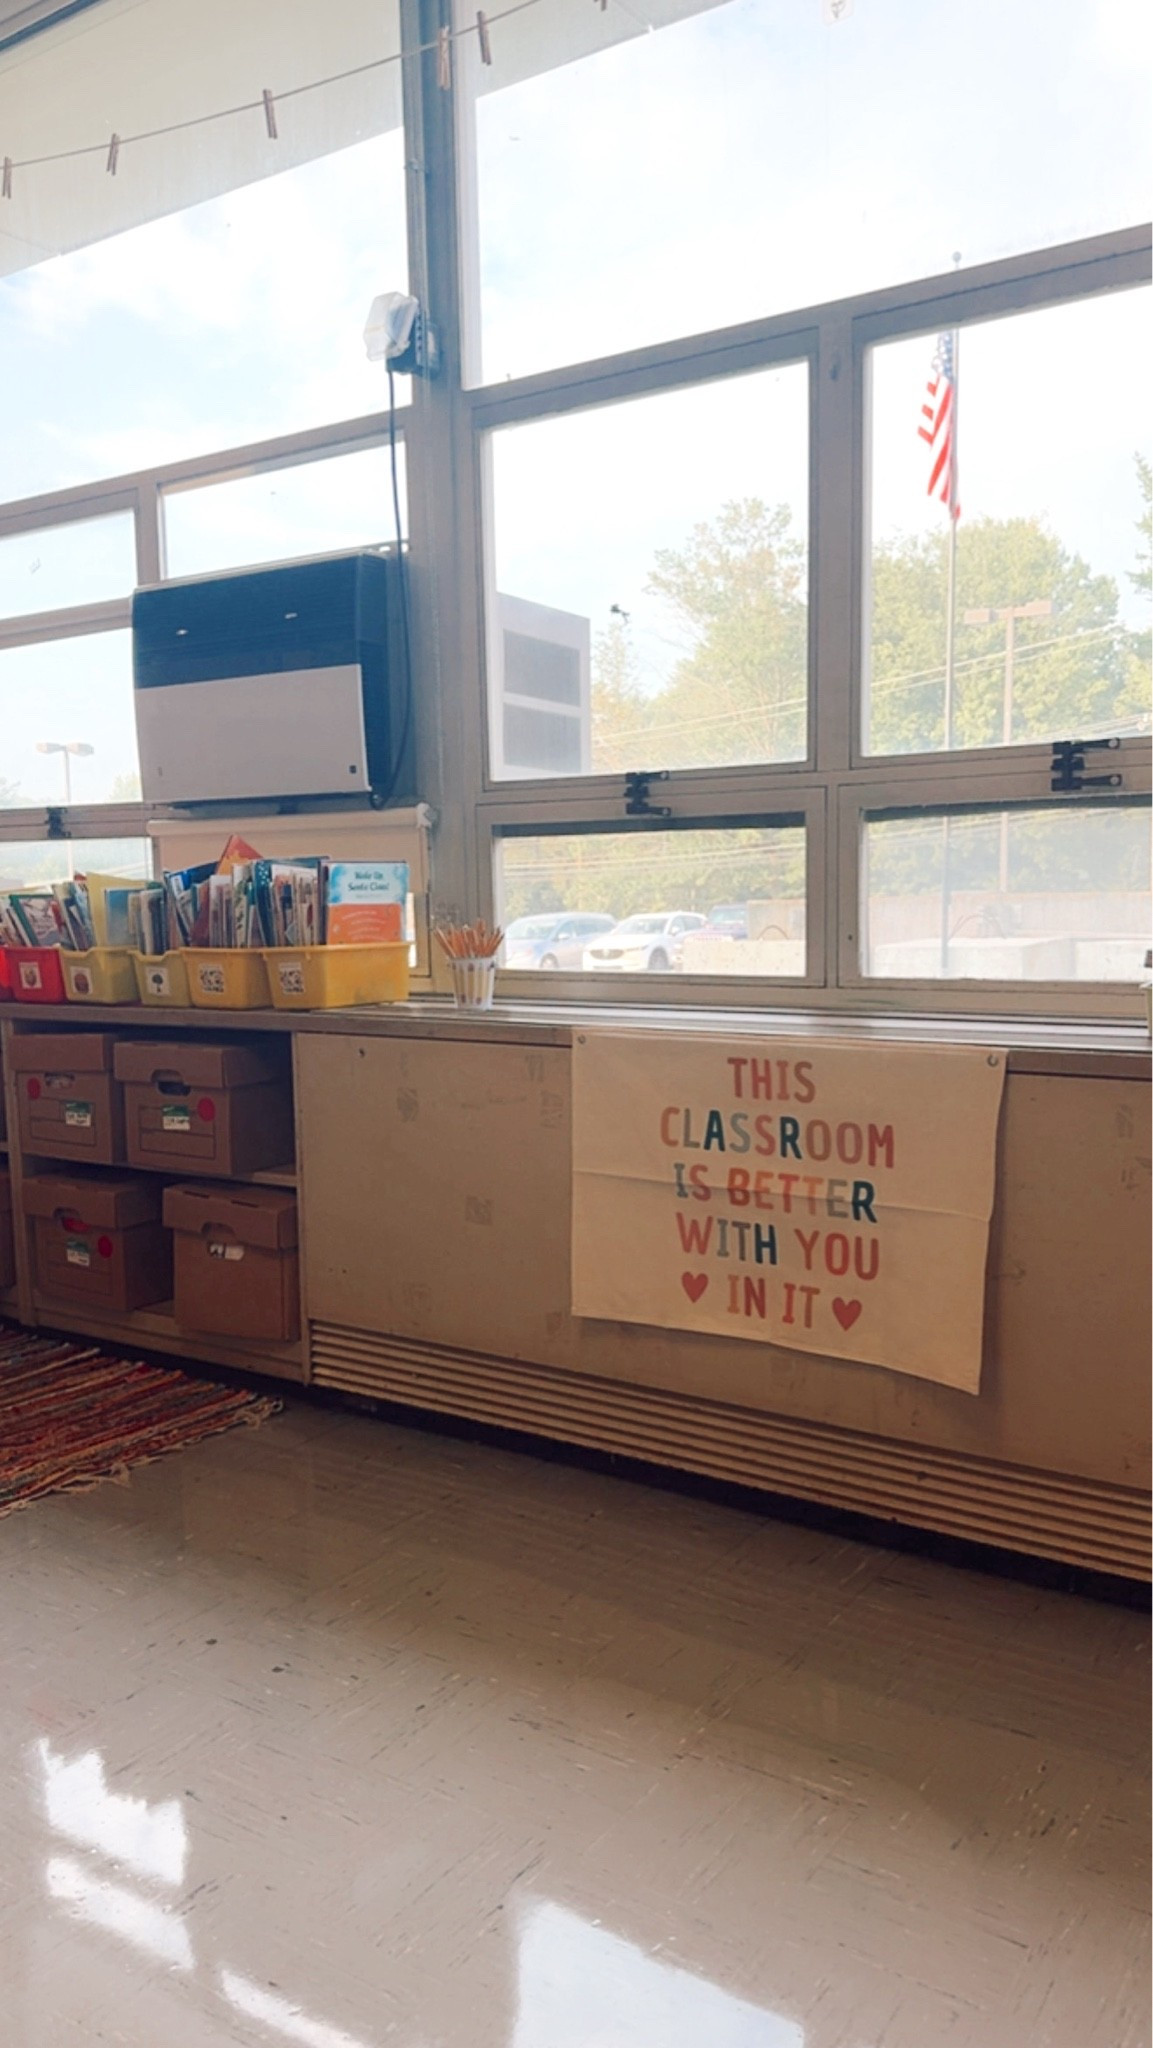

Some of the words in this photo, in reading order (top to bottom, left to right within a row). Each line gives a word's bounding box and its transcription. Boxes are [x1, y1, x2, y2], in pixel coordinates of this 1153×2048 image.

[348, 882, 368, 891] Santa
[727, 1057, 816, 1103] THIS
[660, 1106, 895, 1168] CLASSROOM
[674, 1163, 711, 1202] IS
[727, 1168, 877, 1223] BETTER
[676, 1212, 778, 1265] WITH
[794, 1228, 879, 1281] YOU
[727, 1274, 766, 1319] IN
[782, 1282, 820, 1328] IT
